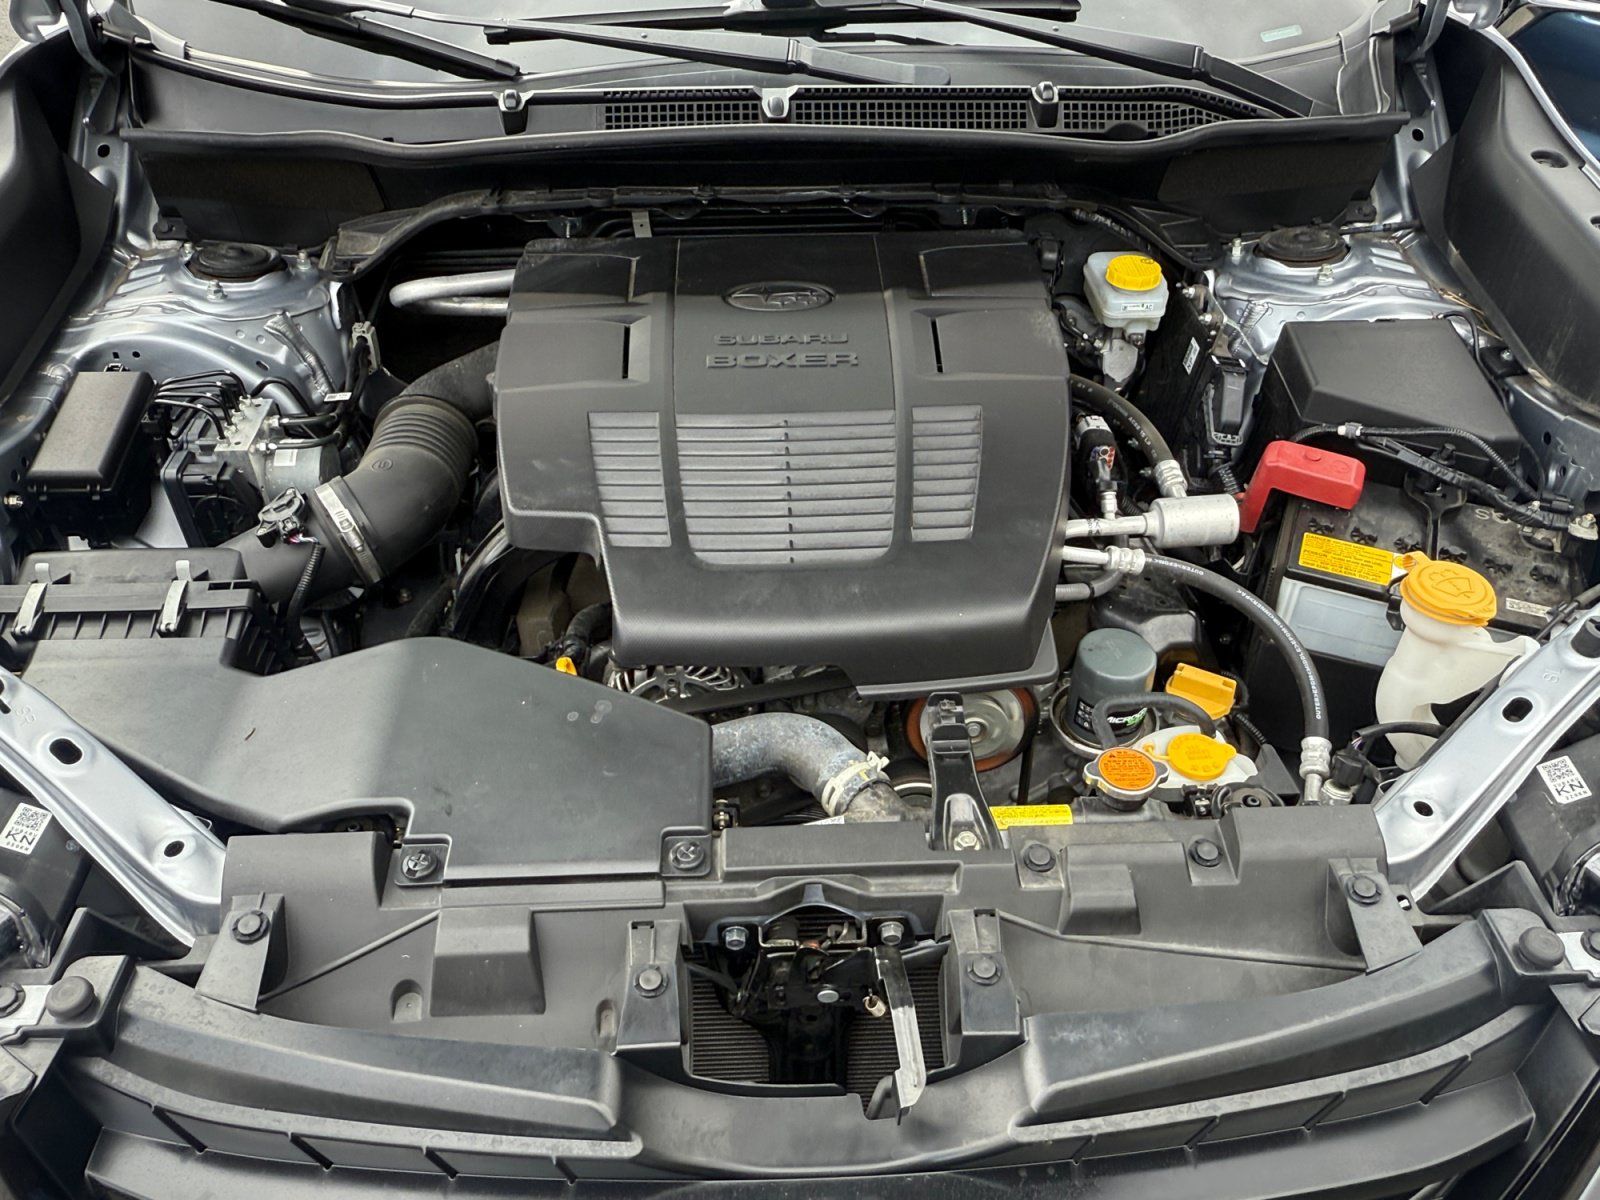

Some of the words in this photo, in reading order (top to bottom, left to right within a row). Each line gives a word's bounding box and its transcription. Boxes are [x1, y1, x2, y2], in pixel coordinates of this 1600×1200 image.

[714, 332, 848, 346] SUBARU
[706, 352, 859, 368] BOXER
[1555, 780, 1584, 796] KN
[5, 830, 35, 846] KN
